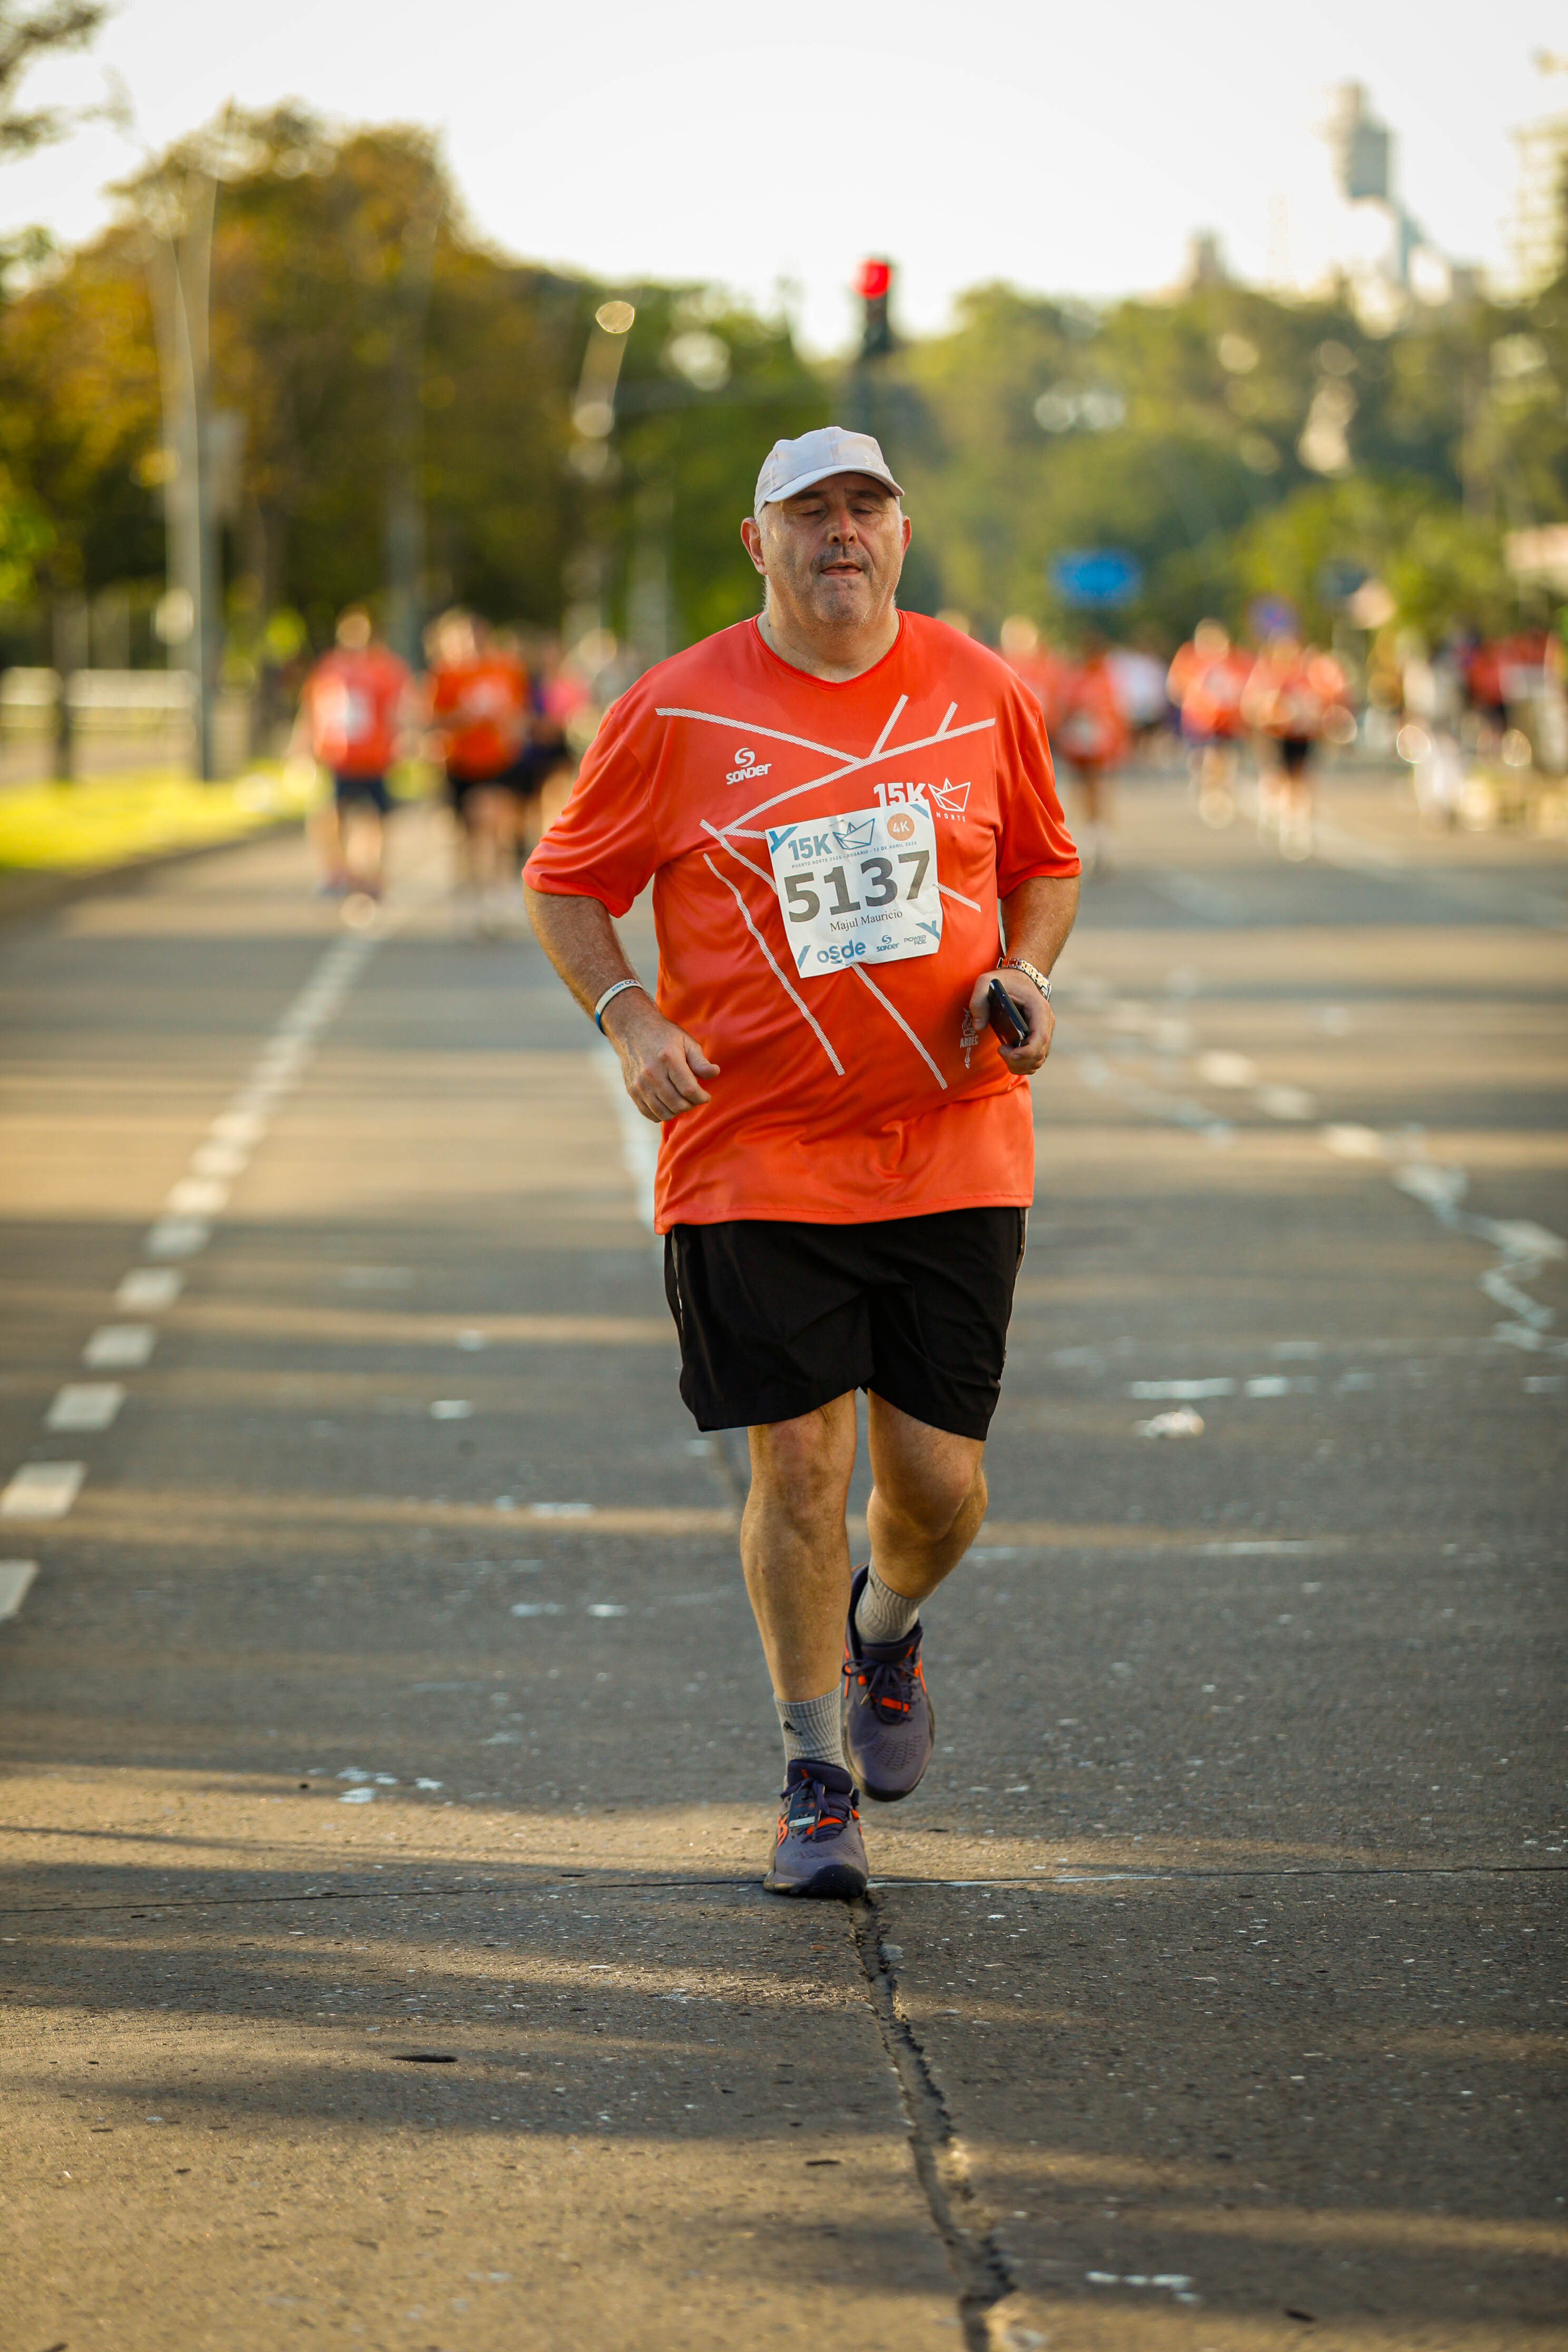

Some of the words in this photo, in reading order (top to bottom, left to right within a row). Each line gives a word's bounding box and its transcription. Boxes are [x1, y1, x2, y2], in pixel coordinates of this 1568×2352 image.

[873, 782, 926, 807] 15K
[893, 820, 910, 833] 4K
[936, 811, 966, 822] NORTE
[788, 833, 832, 860] 15K
[784, 850, 929, 923] 5137
[830, 918, 858, 932] Majul
[860, 909, 903, 925] Mauricio
[904, 934, 926, 943] POWER
[817, 939, 866, 964] osde
[959, 1035, 978, 1048] ARDEC
